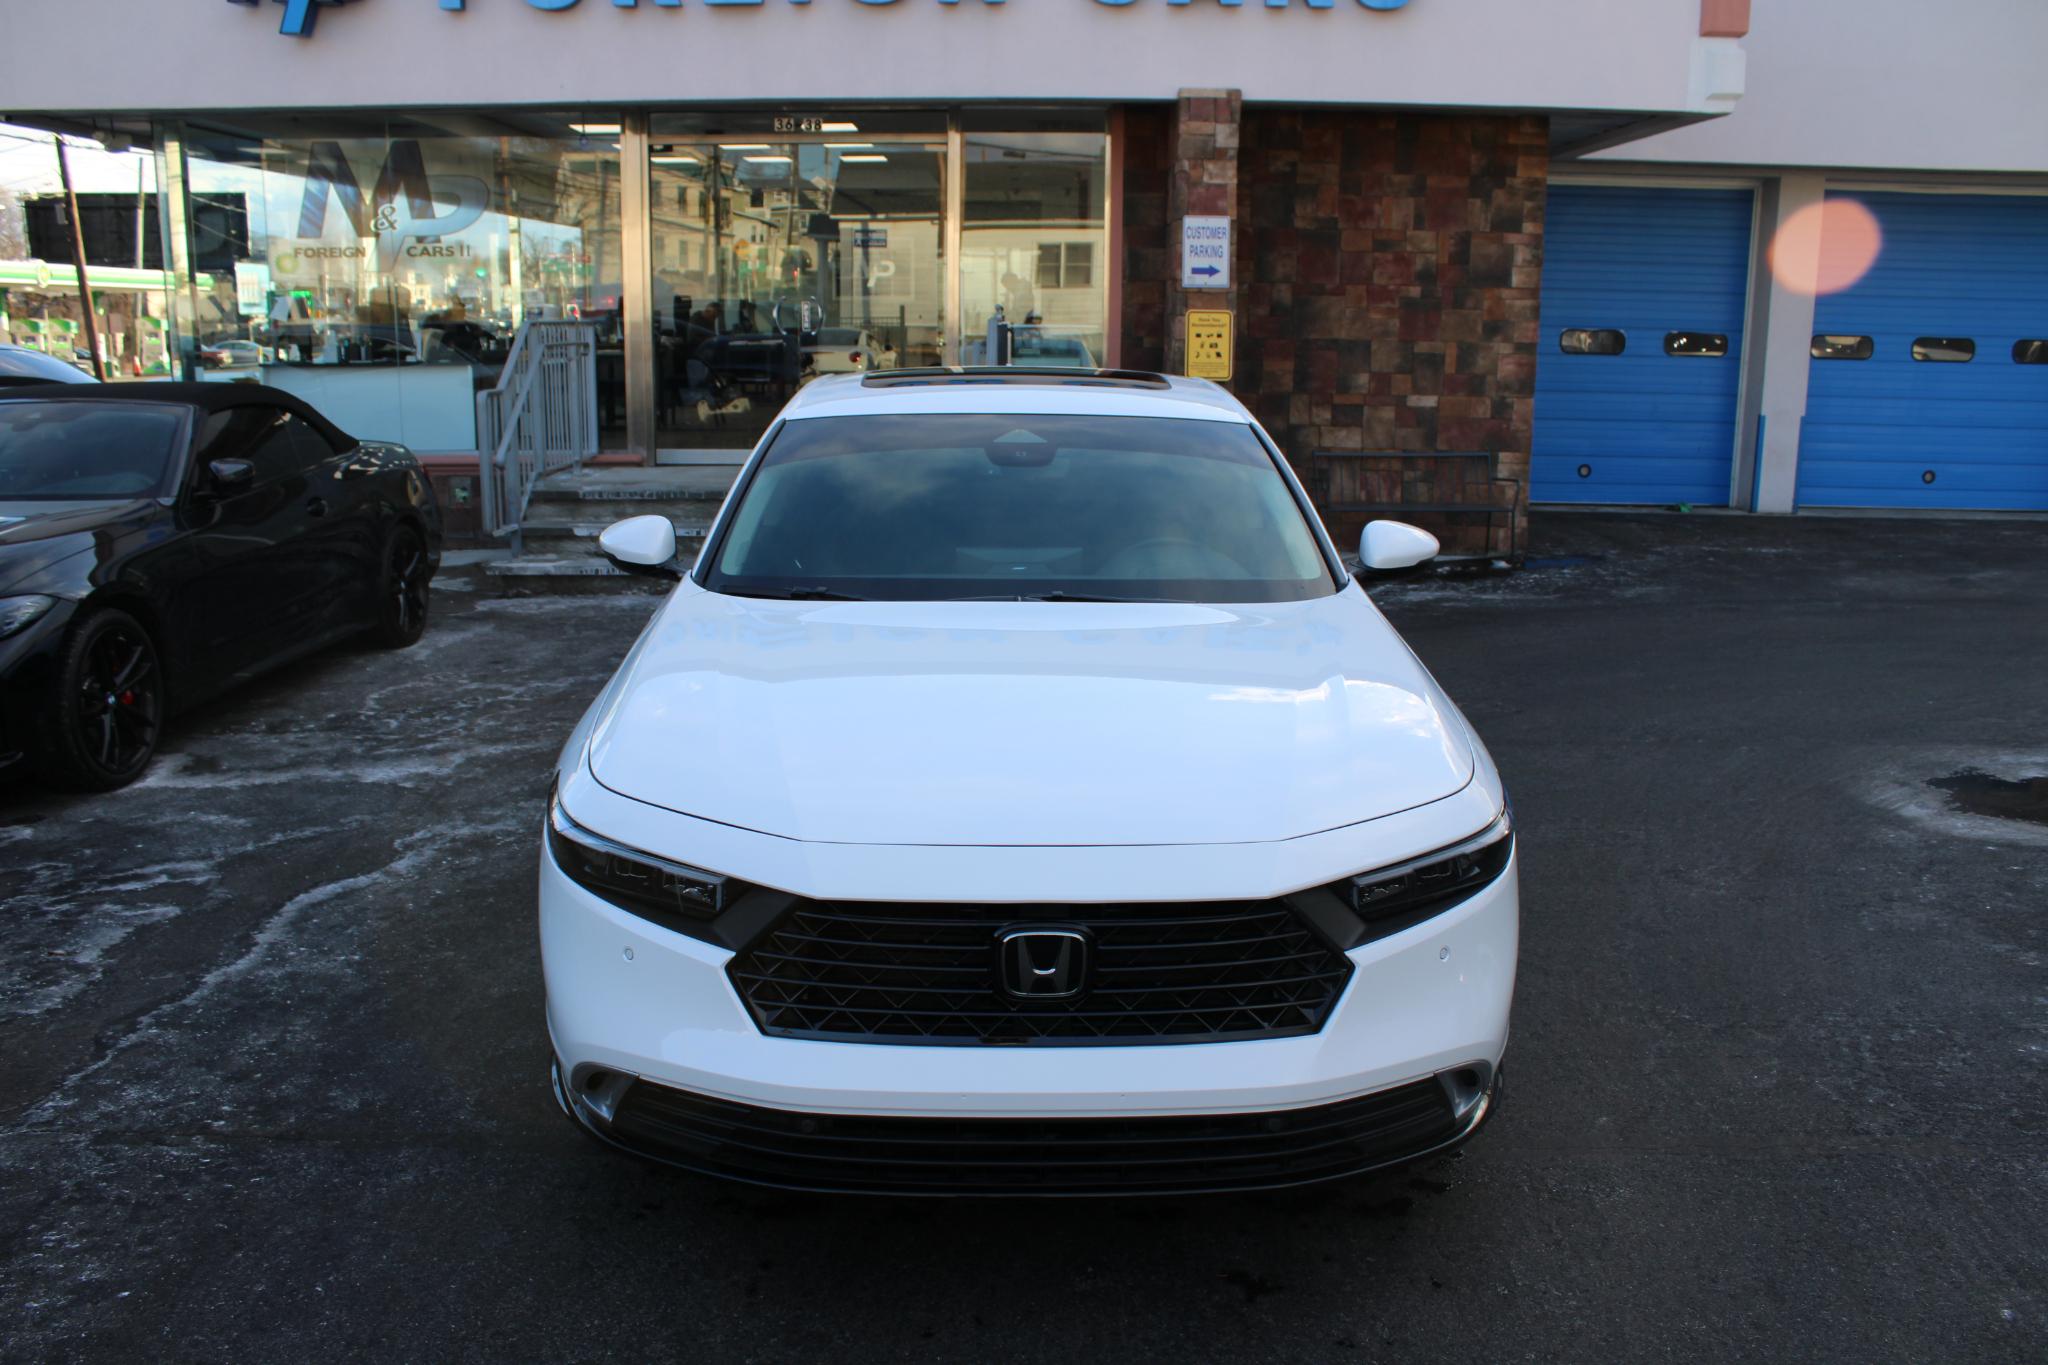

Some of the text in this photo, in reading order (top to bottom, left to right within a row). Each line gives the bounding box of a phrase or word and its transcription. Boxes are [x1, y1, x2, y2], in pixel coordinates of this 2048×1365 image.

[776, 118, 822, 130] 36 38
[1186, 226, 1227, 239] CUSTOMER
[294, 246, 366, 258] FOREIGN
[406, 246, 455, 258] CARS
[1189, 245, 1224, 258] PARKING
